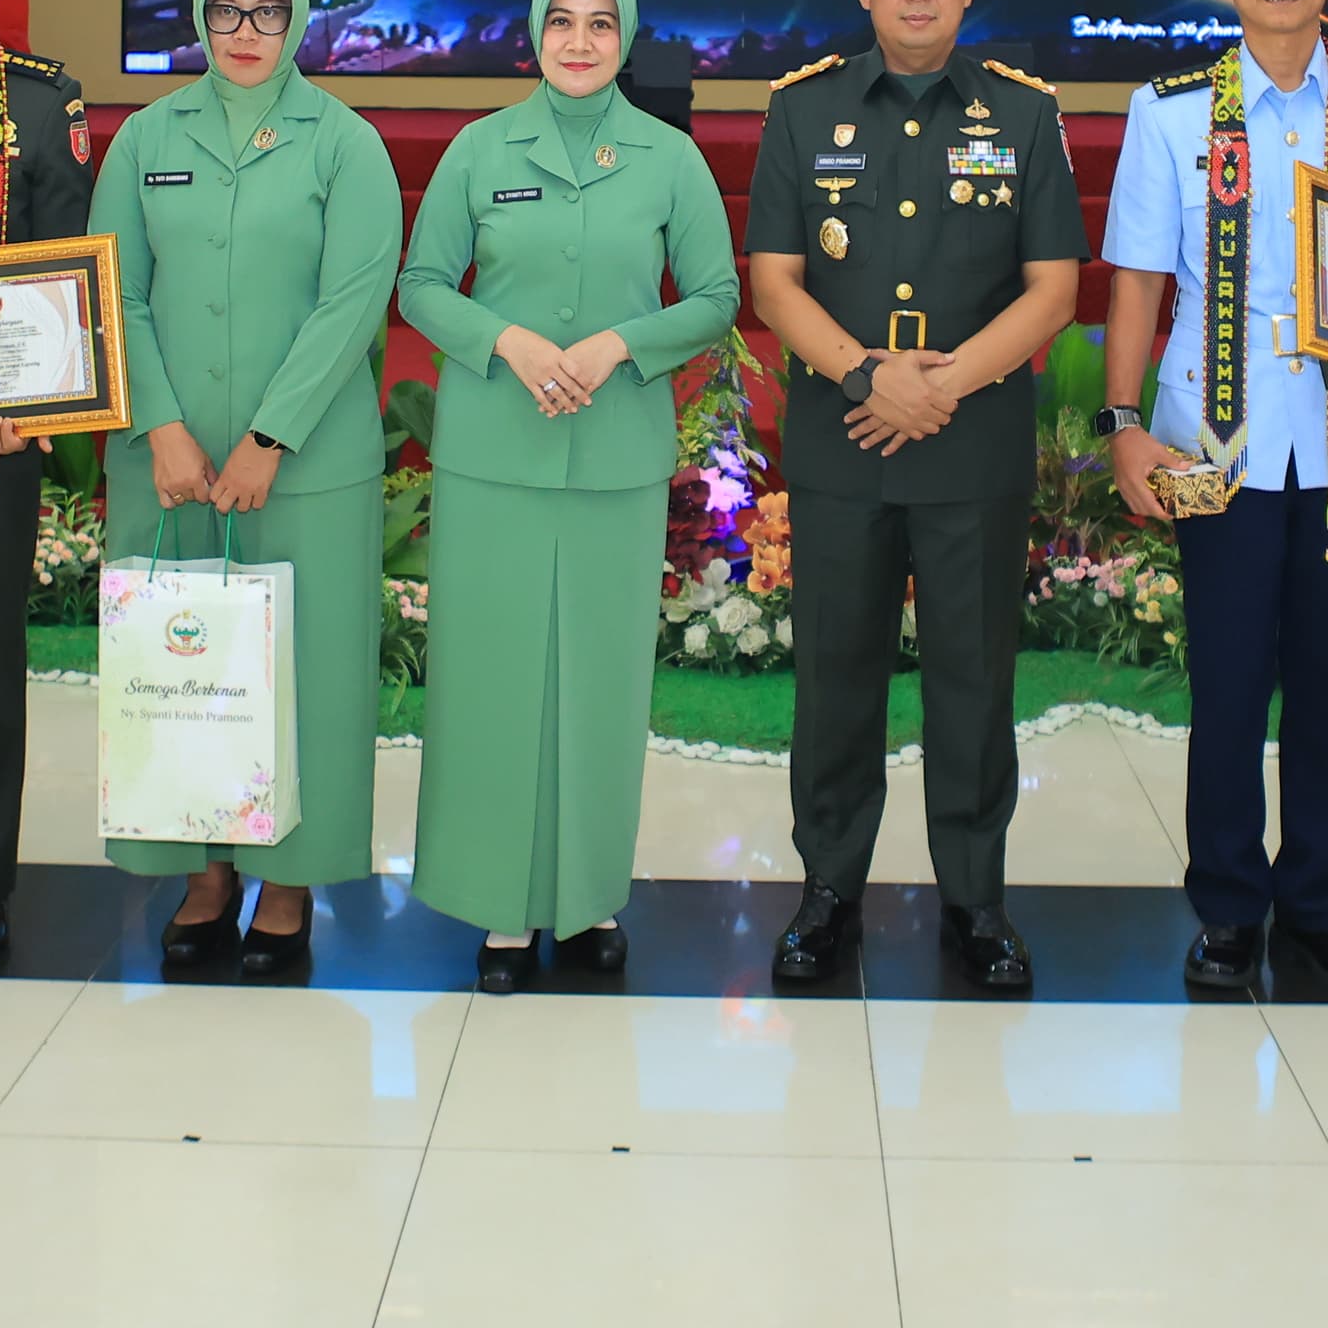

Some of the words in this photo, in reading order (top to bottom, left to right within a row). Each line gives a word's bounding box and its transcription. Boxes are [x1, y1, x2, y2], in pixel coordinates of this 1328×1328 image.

[1216, 219, 1237, 422] MULAWARMAN
[125, 677, 180, 699] Semoga
[181, 679, 248, 697] Berkenan
[139, 708, 172, 724] Syanti
[174, 709, 204, 721] Krido
[206, 710, 254, 724] Pramono
